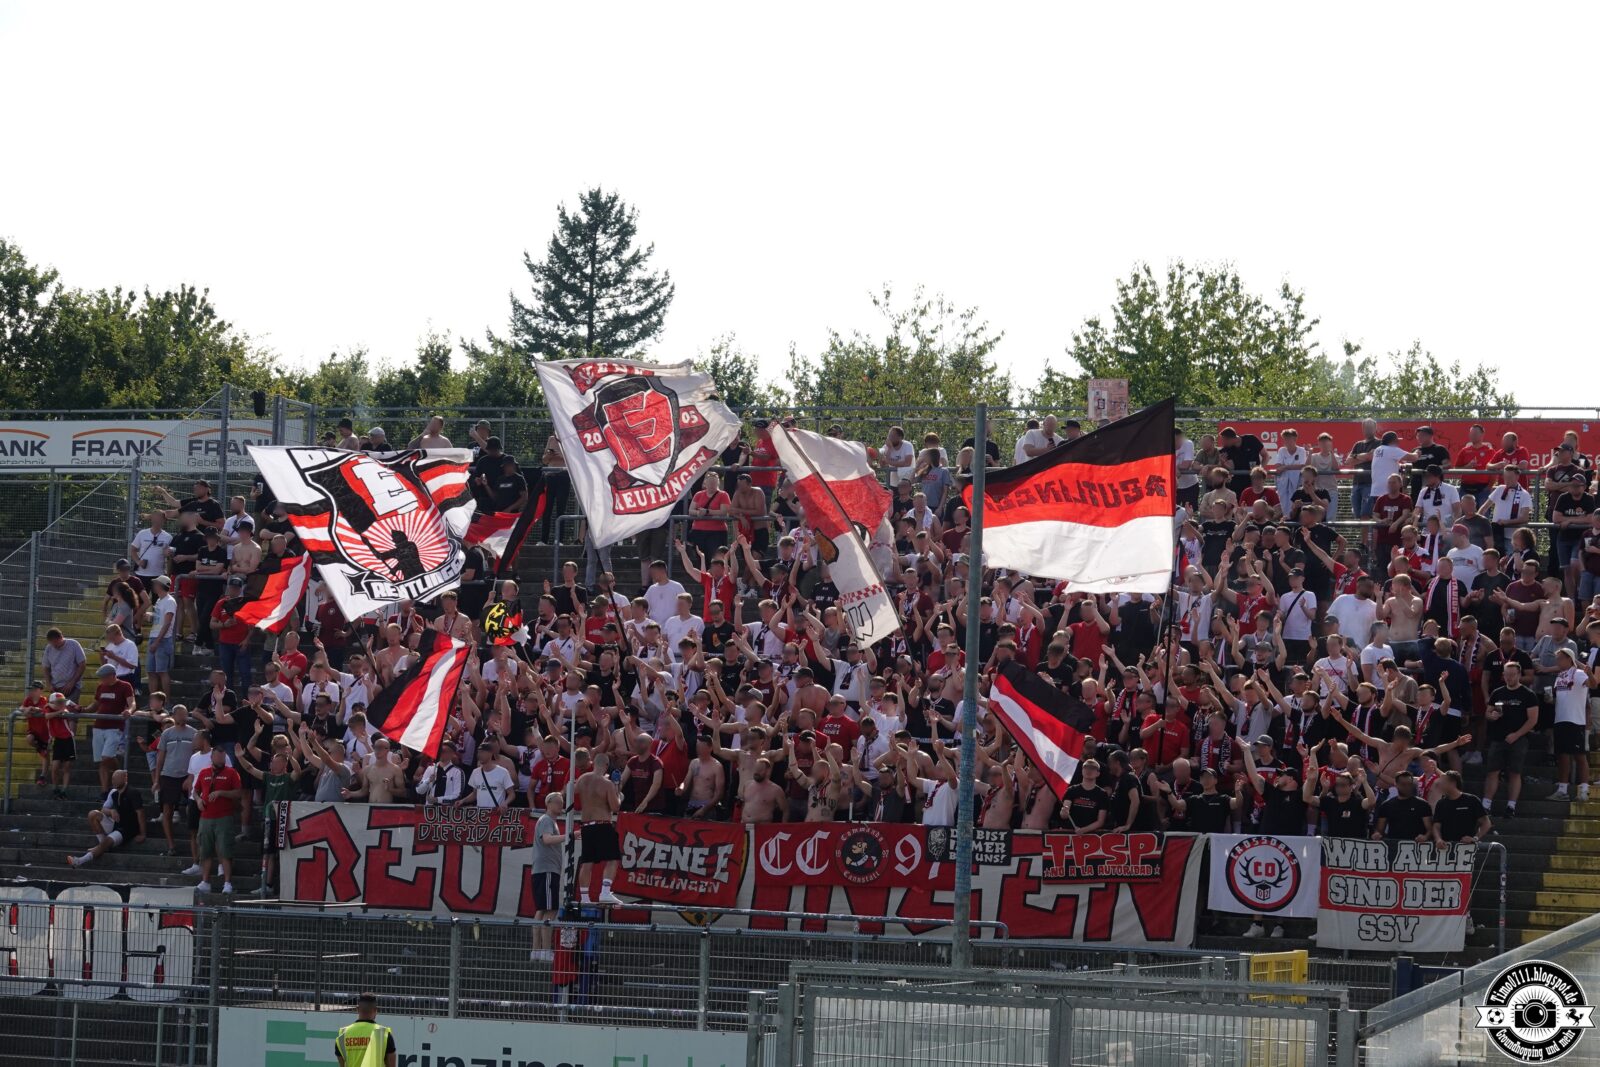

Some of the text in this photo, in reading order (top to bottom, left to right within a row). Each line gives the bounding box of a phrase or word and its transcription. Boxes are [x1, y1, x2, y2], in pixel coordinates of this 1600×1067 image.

[681, 410, 699, 425] 05
[72, 440, 163, 456] FRANK
[188, 439, 270, 456] FRAN
[583, 432, 603, 447] 20
[499, 807, 525, 825] AI
[418, 823, 524, 843] DIFFIDATI
[976, 829, 1008, 842] BIST
[949, 838, 1006, 854] IMER
[1044, 832, 1158, 868] TPSP
[1322, 836, 1476, 872] WIR ALLE
[622, 832, 735, 884] SZENE E
[975, 852, 1007, 863] UNS!
[1050, 865, 1153, 877] NO A LA AUTORIDAD
[628, 871, 720, 894] REUTLINGEN
[1328, 875, 1463, 909] SIND DER
[1358, 914, 1420, 942] SSV
[346, 1037, 370, 1046] SECURI
